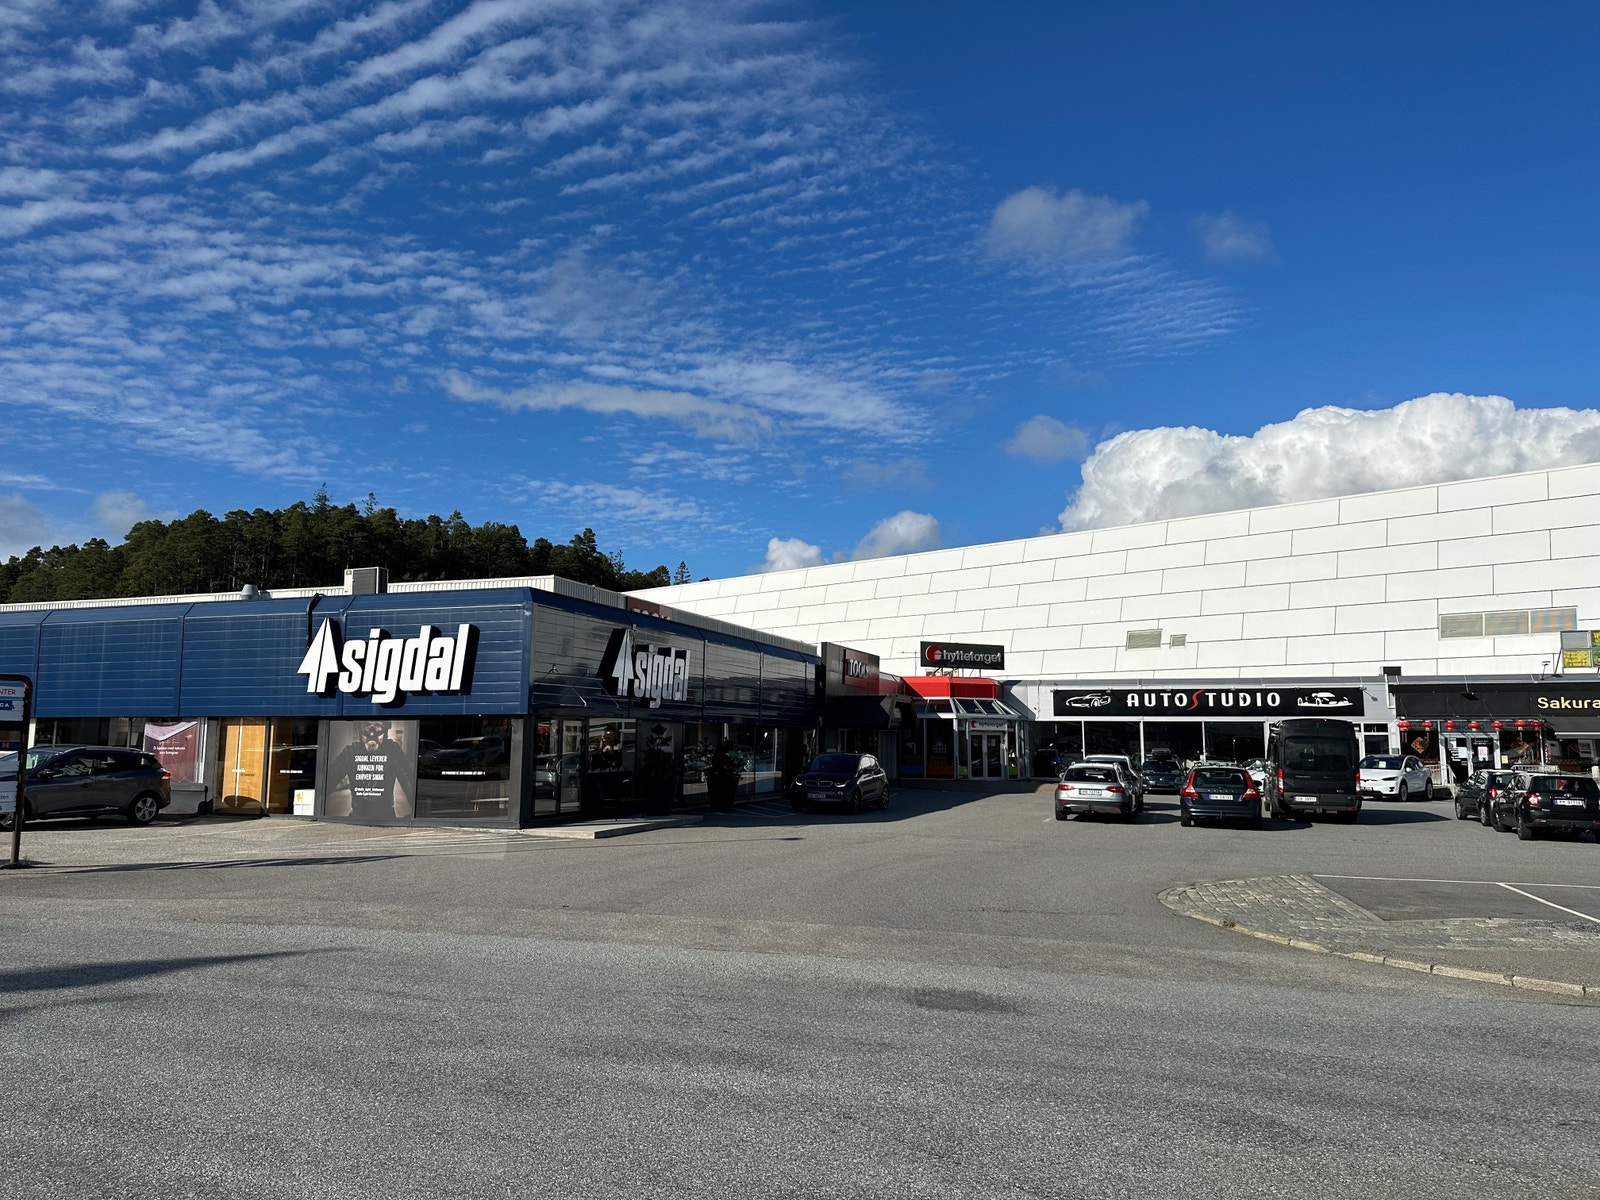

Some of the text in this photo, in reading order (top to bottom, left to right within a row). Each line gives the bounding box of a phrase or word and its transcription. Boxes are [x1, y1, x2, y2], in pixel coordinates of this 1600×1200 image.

[338, 624, 470, 703] sigdal
[634, 644, 691, 709] sigdal
[943, 649, 1002, 664] hyttetorget
[1538, 696, 1600, 709] Sakura
